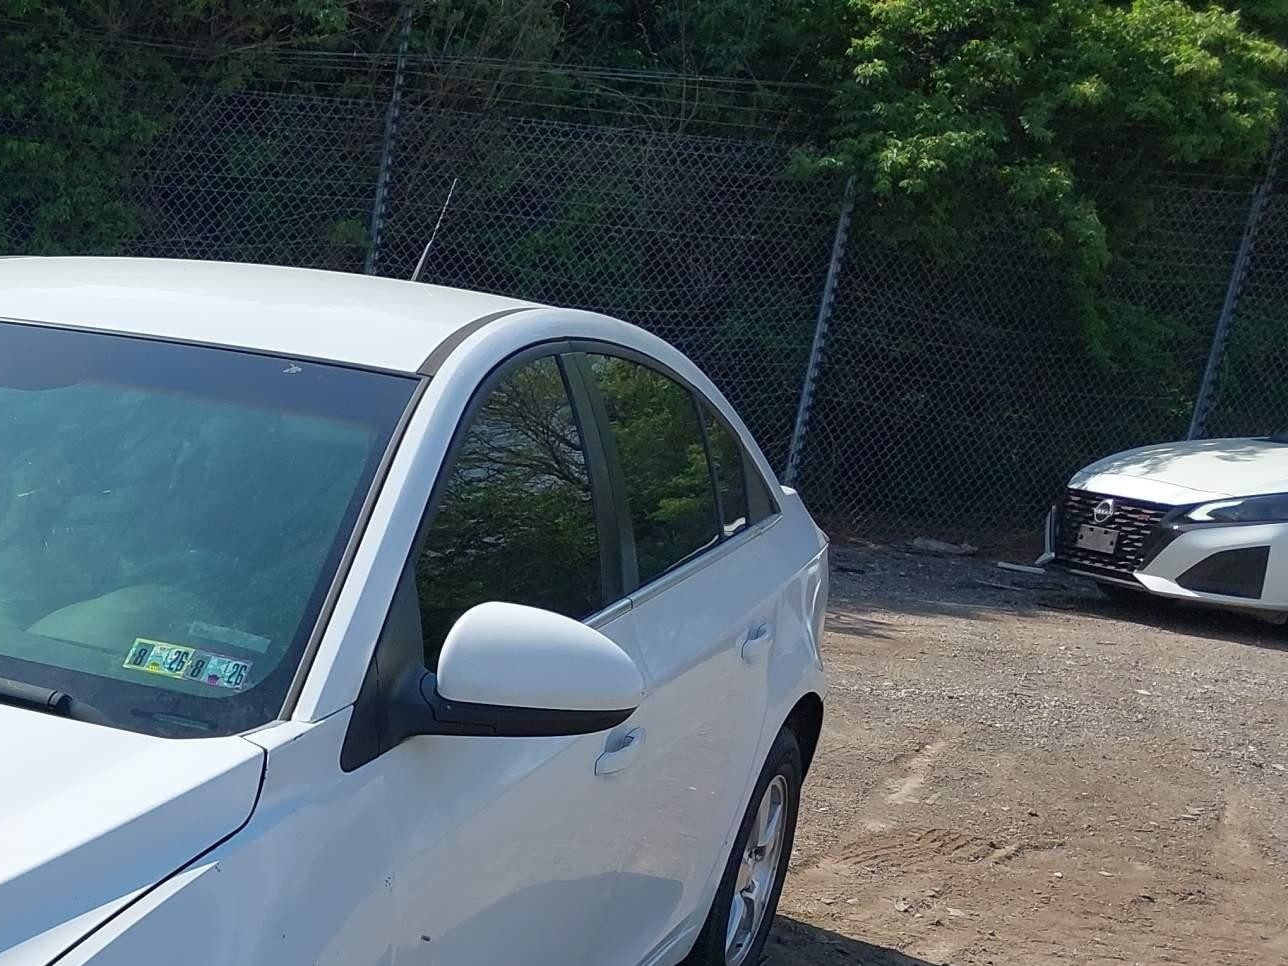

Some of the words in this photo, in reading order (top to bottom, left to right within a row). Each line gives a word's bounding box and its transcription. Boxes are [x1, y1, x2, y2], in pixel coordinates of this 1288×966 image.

[134, 648, 148, 666] 8
[168, 650, 189, 672] 26
[191, 659, 205, 678] 8
[227, 663, 248, 686] 26
